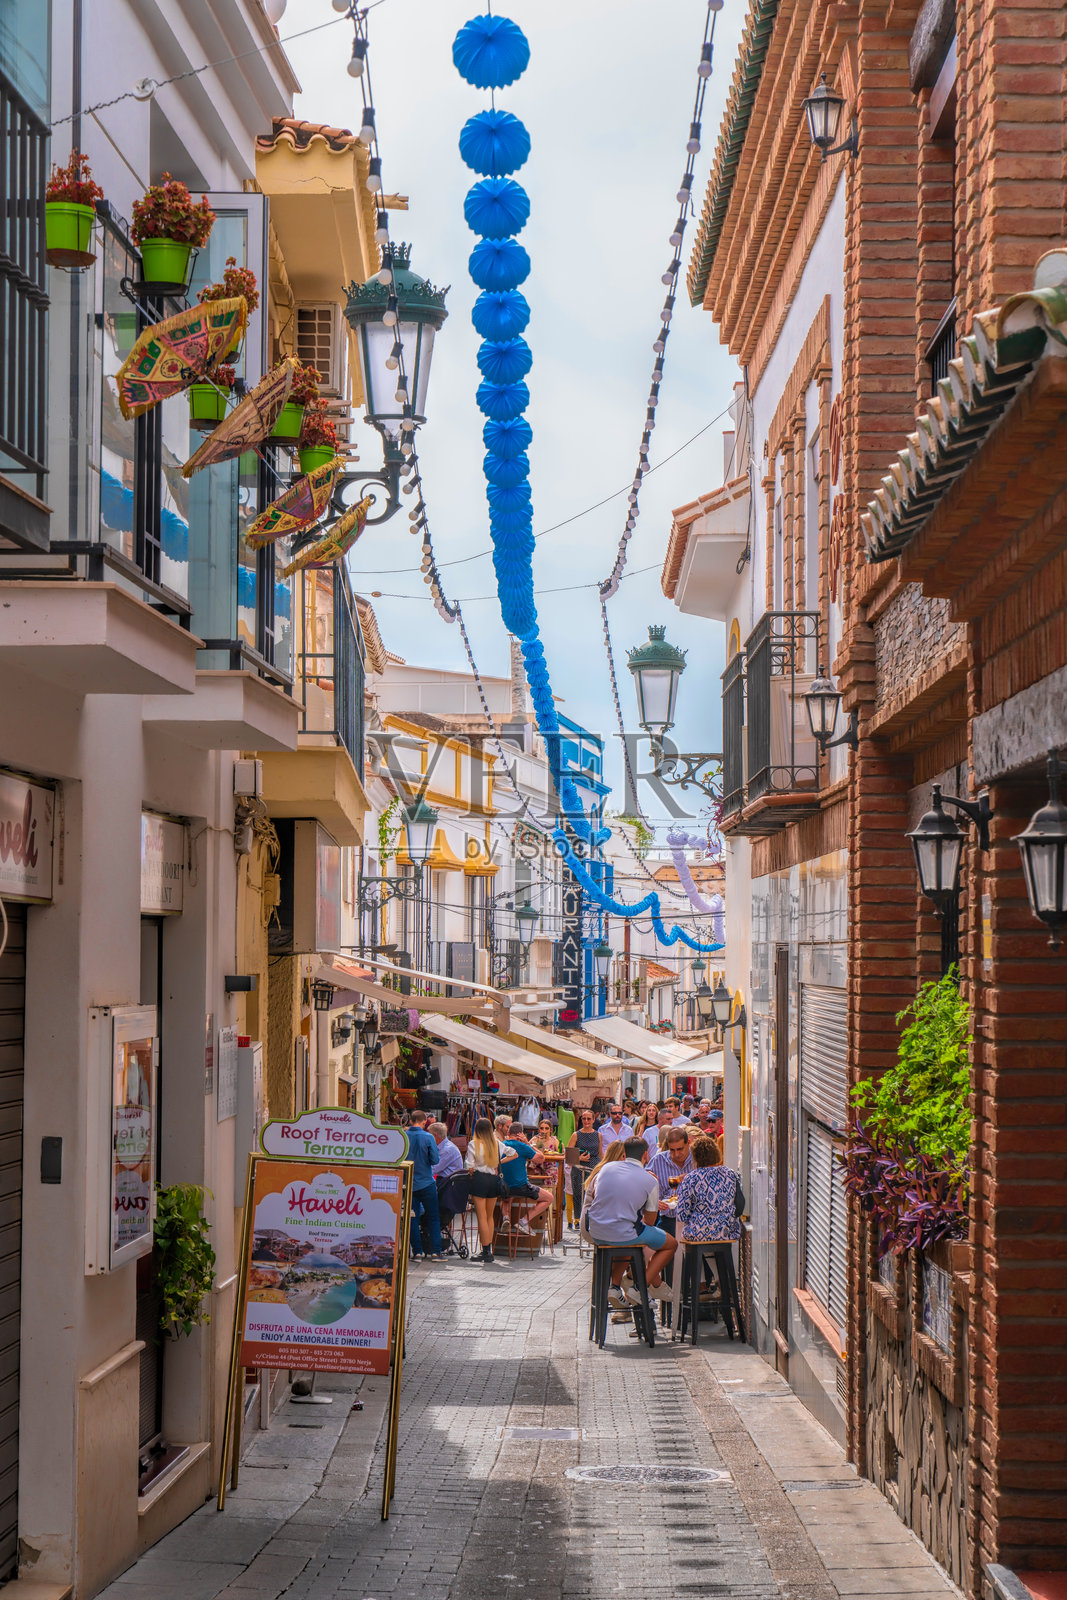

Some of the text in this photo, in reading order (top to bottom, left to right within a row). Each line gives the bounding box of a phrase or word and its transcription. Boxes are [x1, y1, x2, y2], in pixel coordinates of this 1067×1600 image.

[320, 1113, 352, 1123] Haveli
[281, 1126, 389, 1145] Roof Terrace
[303, 1141, 365, 1158] Terraza
[288, 1187, 363, 1217] Haveli
[285, 1217, 366, 1229] Fine Indian Cuisine
[248, 1323, 385, 1339] DISFRUTA DE UNA CENA MEMORABLE!
[261, 1333, 371, 1347] ENJOY A MEMORABLE DINNER!
[252, 1360, 308, 1369] www.havelinerja.com
